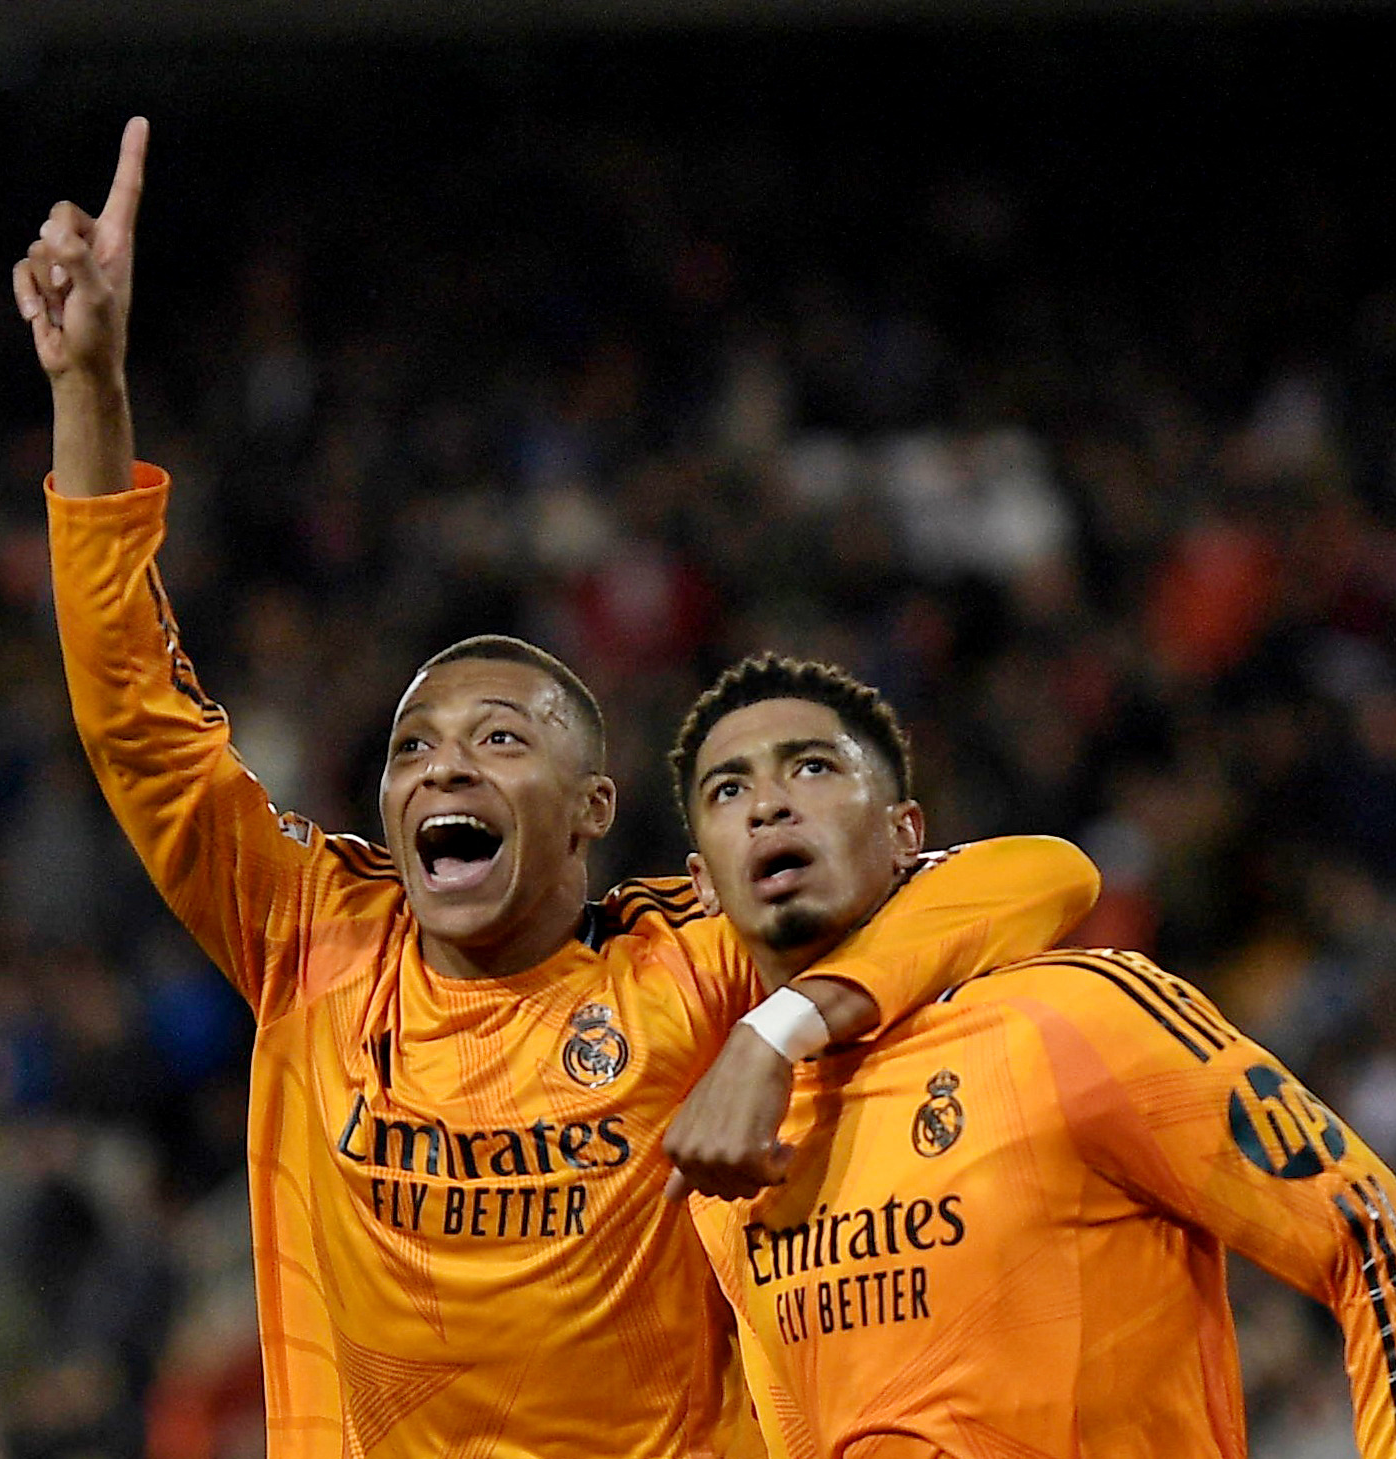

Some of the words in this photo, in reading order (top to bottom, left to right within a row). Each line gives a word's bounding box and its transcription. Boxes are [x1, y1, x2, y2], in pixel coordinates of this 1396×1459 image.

[1229, 1065, 1345, 1178] hp
[371, 1179, 427, 1231] FLY
[443, 1185, 587, 1237] BETTER
[743, 1194, 965, 1286] Emirates
[775, 1286, 808, 1345] FLY
[818, 1267, 929, 1333] BETTER
